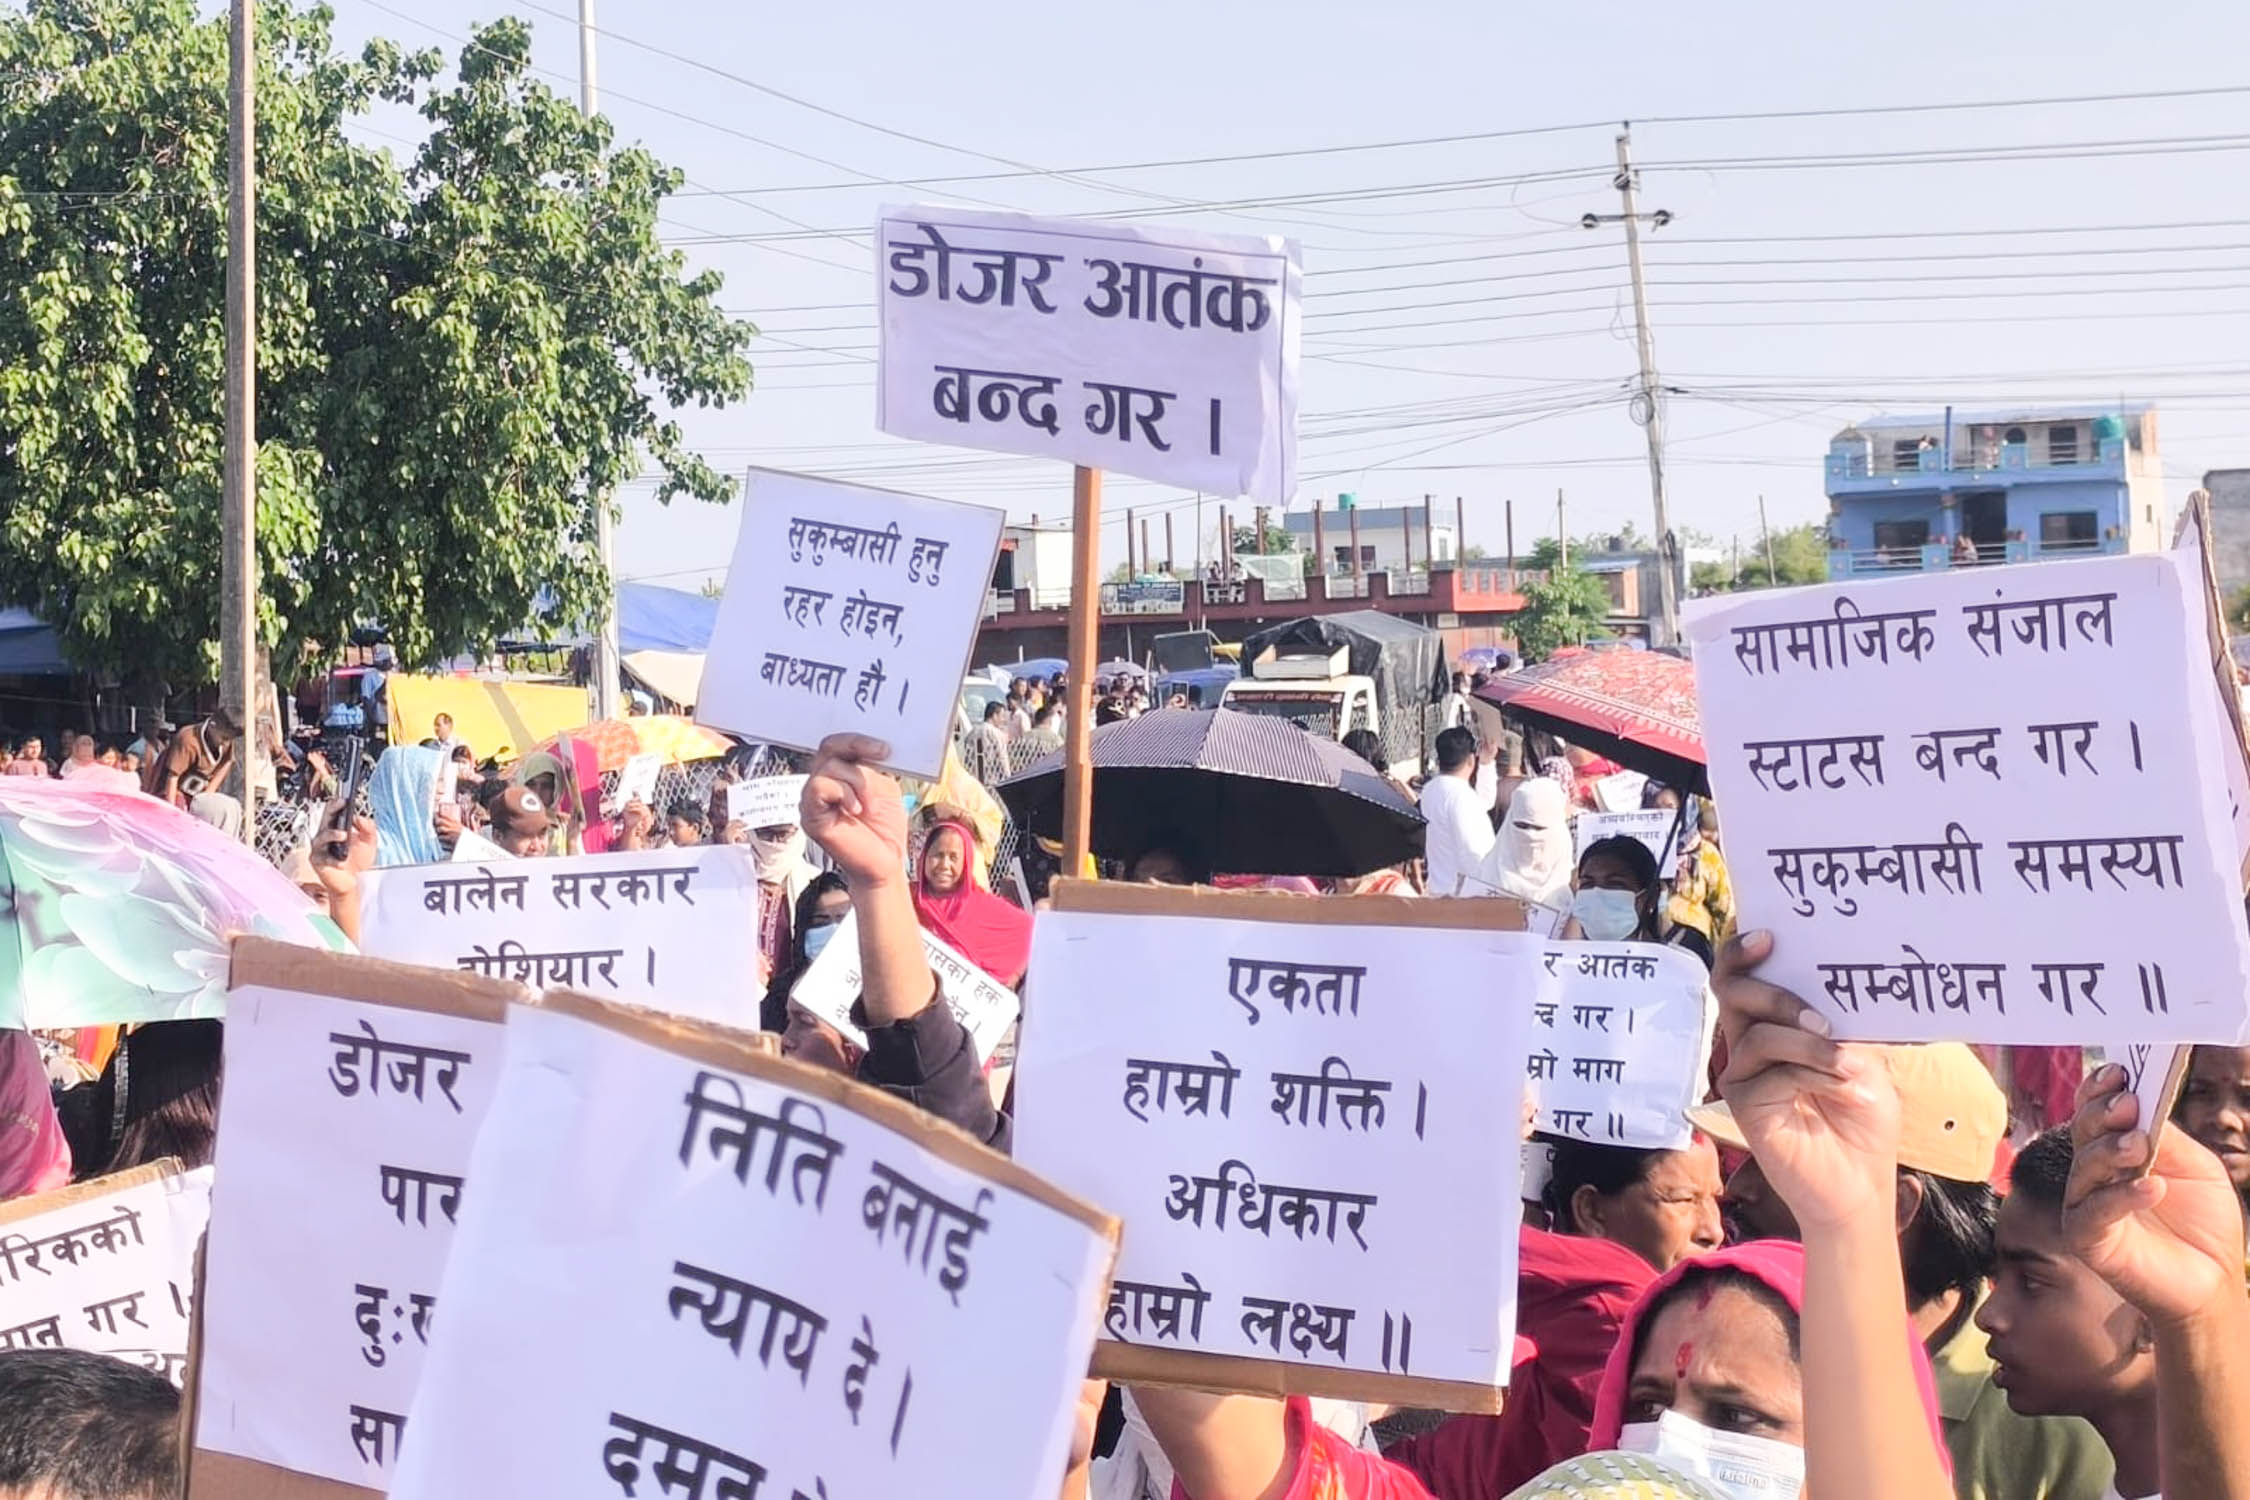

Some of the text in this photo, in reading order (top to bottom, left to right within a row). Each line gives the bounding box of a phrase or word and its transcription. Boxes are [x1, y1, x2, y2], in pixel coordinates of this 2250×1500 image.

[888, 225, 1277, 334] डोजर आतंक
[933, 365, 1063, 437] बन्द
[1082, 381, 1177, 452] गर
[788, 517, 950, 587] सुकुम्बासी हुनु
[783, 585, 905, 648] रहर होइन,
[1730, 588, 2118, 676] सामाजिक संजाल
[760, 652, 848, 697] बाध्यता
[854, 669, 887, 713] हौ
[1743, 734, 1885, 792] स्टाटस
[1911, 727, 2002, 782] बन्द
[2027, 721, 2099, 777] गर
[423, 859, 700, 916] बालेन सरकार
[1766, 821, 2184, 918] सुकुम्बासी समस्या
[1228, 957, 1368, 1026] एकता
[1577, 949, 1659, 981] आतंक
[1816, 944, 2007, 1015] सम्बोधन
[2031, 962, 2107, 1016] गर
[1572, 1005, 1614, 1033] गर
[328, 1019, 472, 1114] डोजर
[1123, 1050, 1242, 1123] हाम्रो
[1270, 1055, 1393, 1132] शक्ति
[1572, 1057, 1626, 1085] माग
[1551, 1109, 1593, 1140] गर
[678, 1071, 994, 1306] निति बनाई
[1165, 1159, 1378, 1252] अधिकार
[82, 1290, 149, 1335] गर
[668, 1260, 829, 1385] न्याय
[843, 1315, 880, 1426] दे
[1103, 1272, 1212, 1346] हाम्रो
[1239, 1296, 1356, 1363] लक्ष्य
[602, 1411, 768, 1500] दमन
